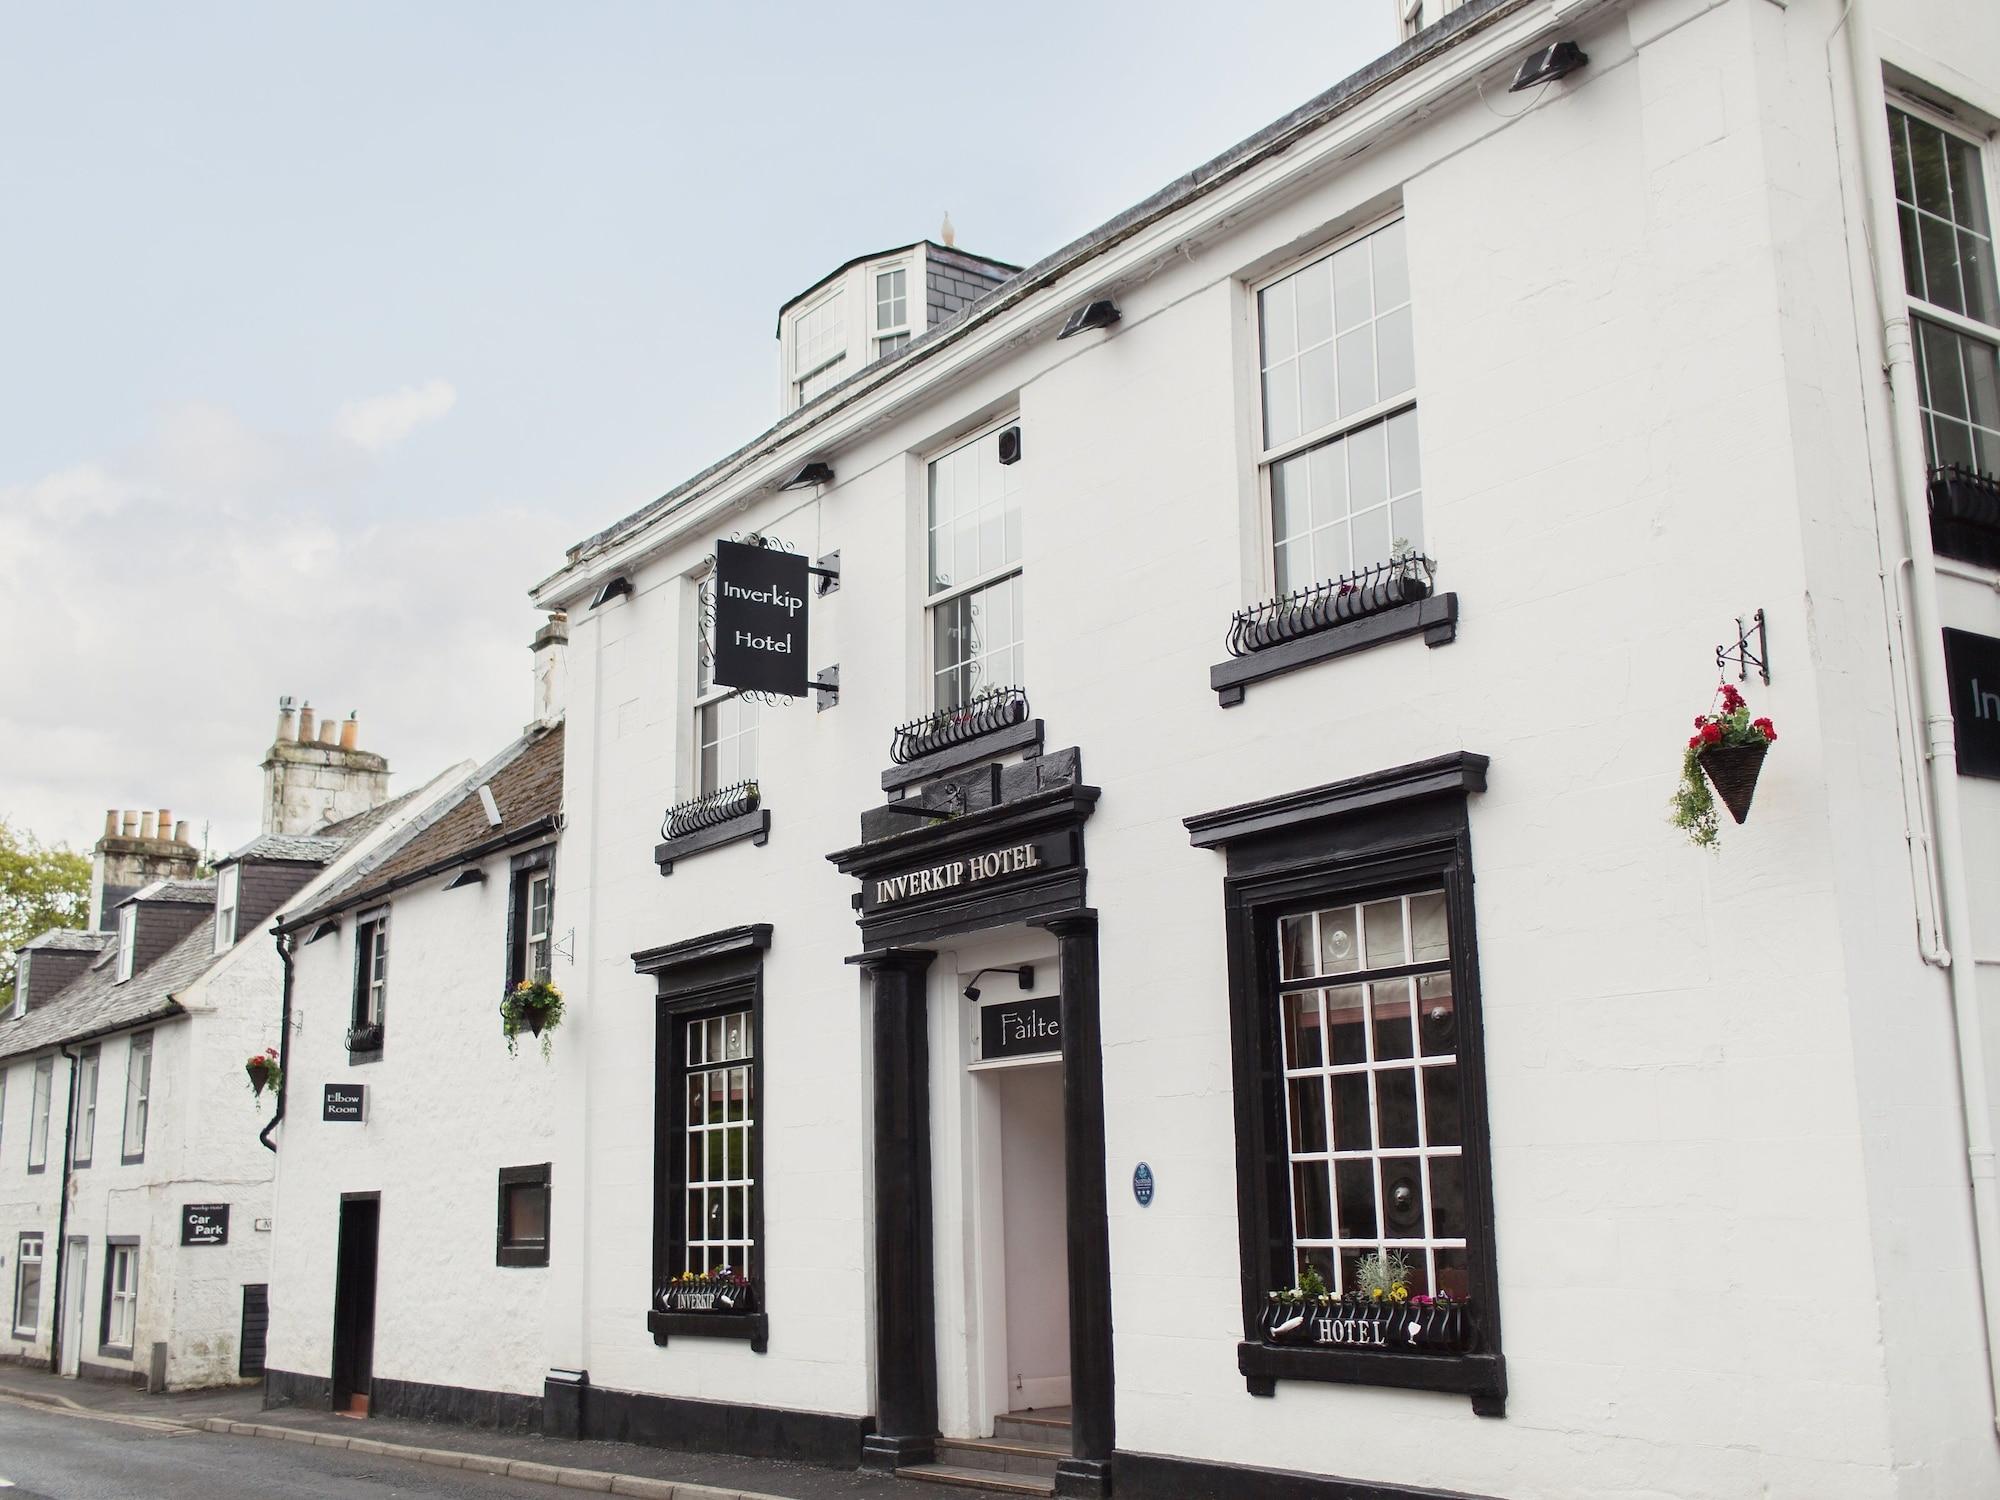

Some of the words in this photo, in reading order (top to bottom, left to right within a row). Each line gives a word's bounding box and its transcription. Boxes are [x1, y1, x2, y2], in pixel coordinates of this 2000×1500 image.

[724, 581, 803, 618] Inverkip
[735, 630, 792, 654] Hotel
[876, 861, 964, 904] INVERKIP
[969, 843, 1038, 882] HOTEL
[1001, 1009, 1060, 1046] Fàilte
[327, 1092, 360, 1103] Elbow
[328, 1104, 358, 1114] Room
[189, 1215, 211, 1225] Car
[195, 1225, 224, 1235] Park
[677, 1293, 715, 1309] INVERKIP
[1318, 1319, 1385, 1344] HOTEL
